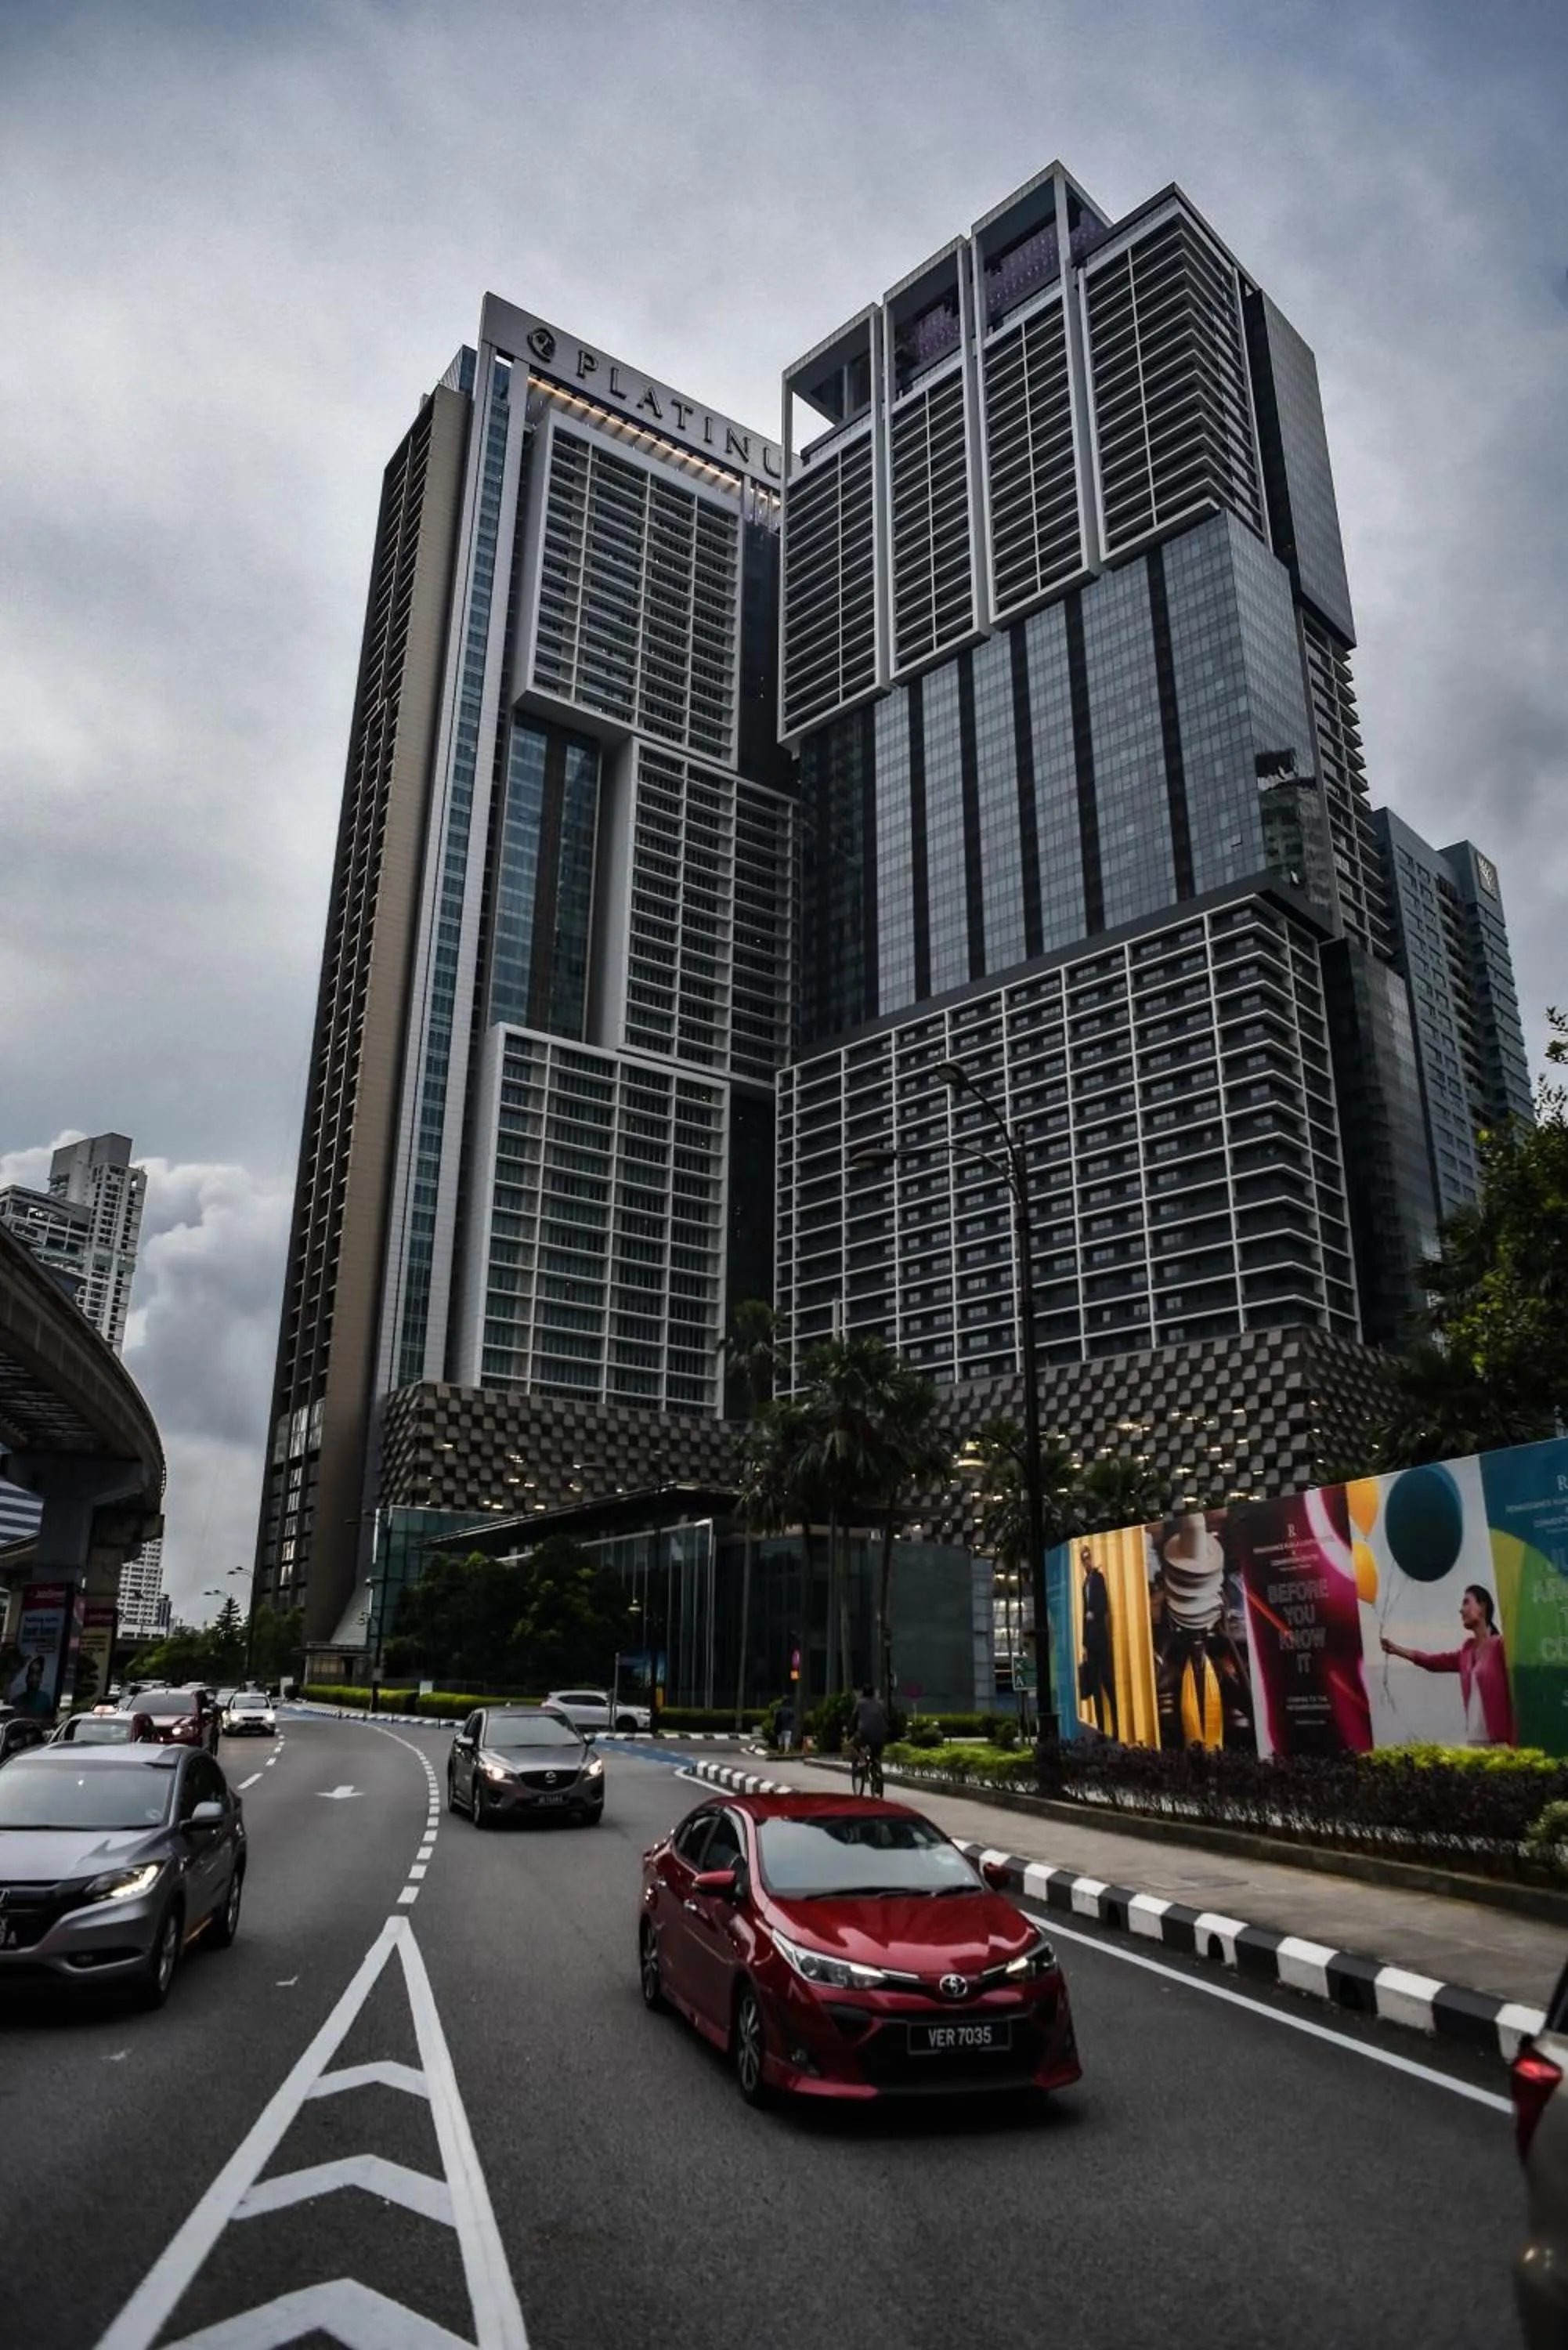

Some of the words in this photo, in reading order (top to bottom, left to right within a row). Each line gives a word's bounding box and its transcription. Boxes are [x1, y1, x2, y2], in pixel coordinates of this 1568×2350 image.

[1266, 1578, 1330, 1604] BEFORE
[1282, 1603, 1316, 1627] YOU
[1278, 1627, 1327, 1650] KNOW
[1295, 1652, 1312, 1673] IT
[927, 2027, 956, 2048] VER
[956, 2025, 992, 2046] 7035
